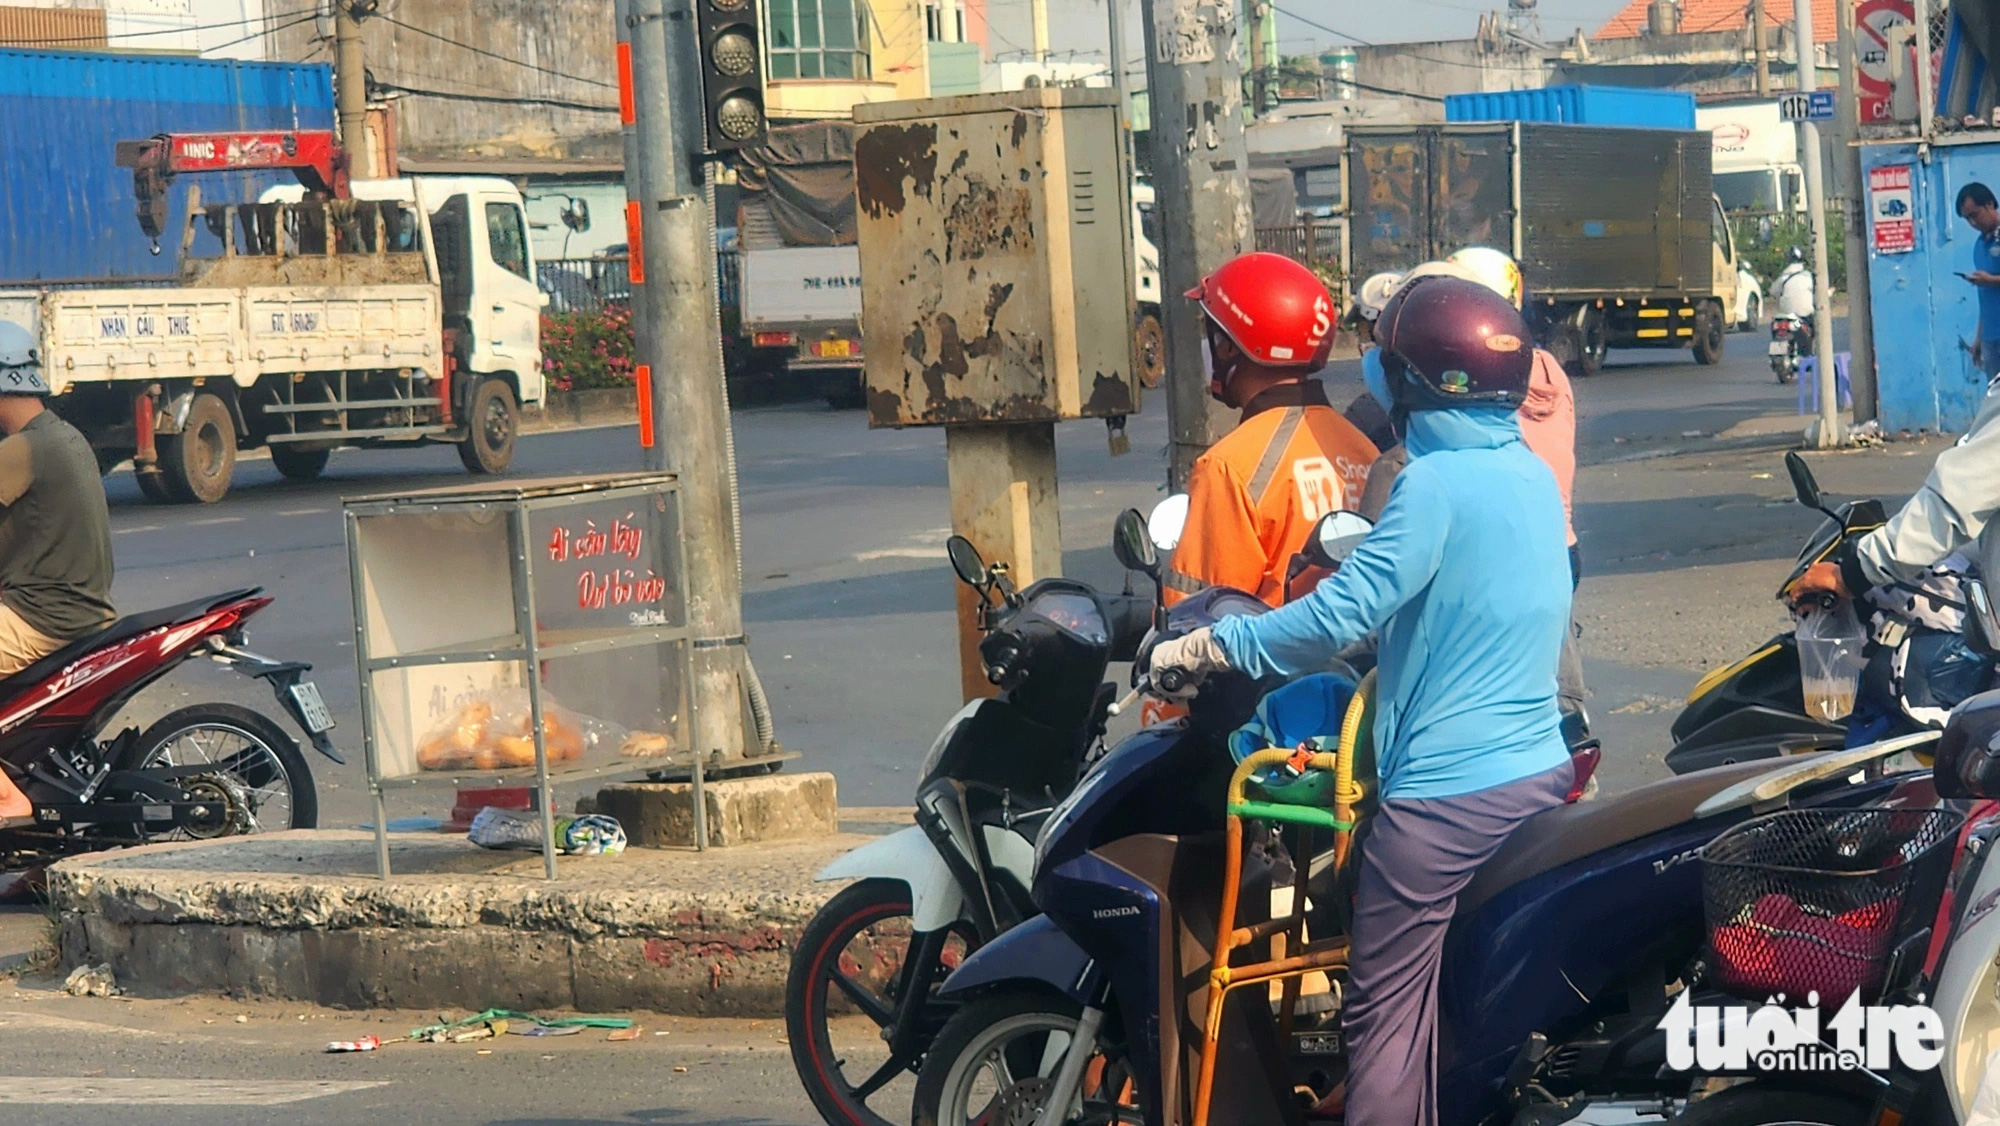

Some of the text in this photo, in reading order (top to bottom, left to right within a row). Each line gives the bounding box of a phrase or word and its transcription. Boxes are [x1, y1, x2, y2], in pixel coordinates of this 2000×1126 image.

[548, 527, 570, 562] Ai
[574, 519, 607, 559] cần
[1093, 905, 1141, 919] HONDA
